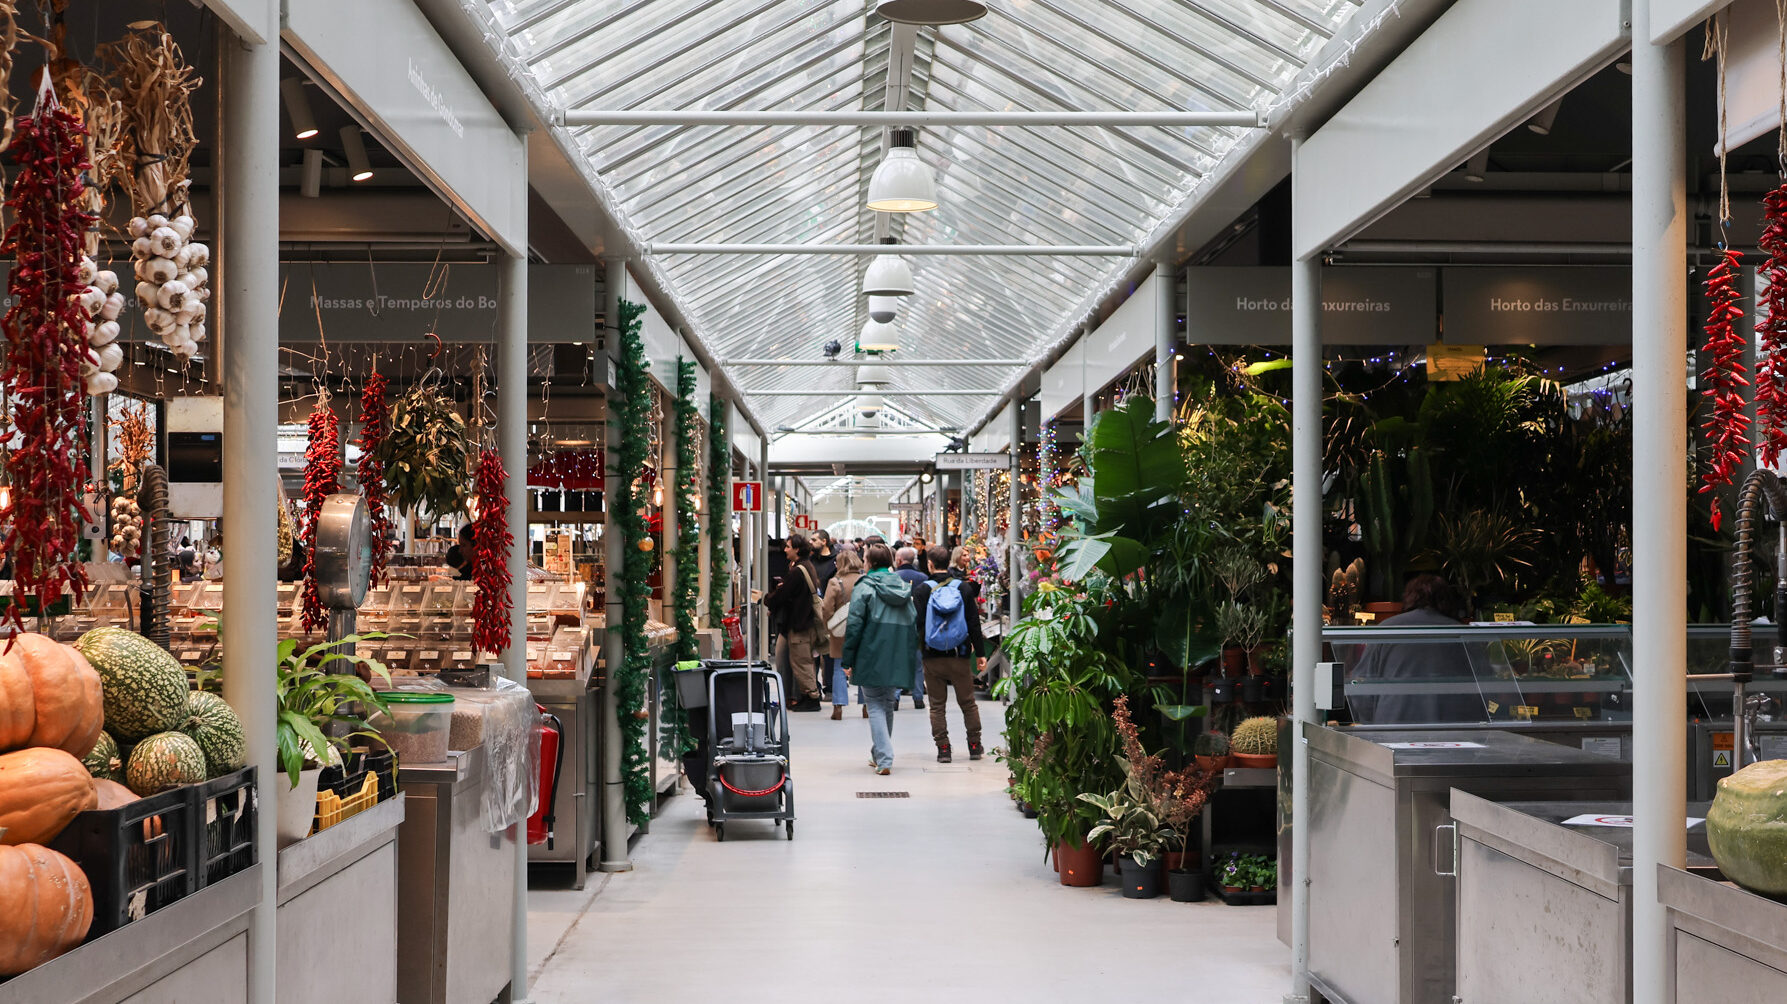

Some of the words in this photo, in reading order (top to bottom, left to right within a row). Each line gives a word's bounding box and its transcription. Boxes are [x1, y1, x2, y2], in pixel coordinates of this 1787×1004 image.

[310, 296, 363, 309] Massas
[378, 296, 453, 312] Temperos
[455, 296, 474, 309] do
[478, 296, 497, 309] Bo
[1236, 297, 1278, 311] Horto
[1321, 298, 1391, 312] nxurreiras
[1490, 297, 1532, 311] Horto
[1534, 297, 1560, 311] das
